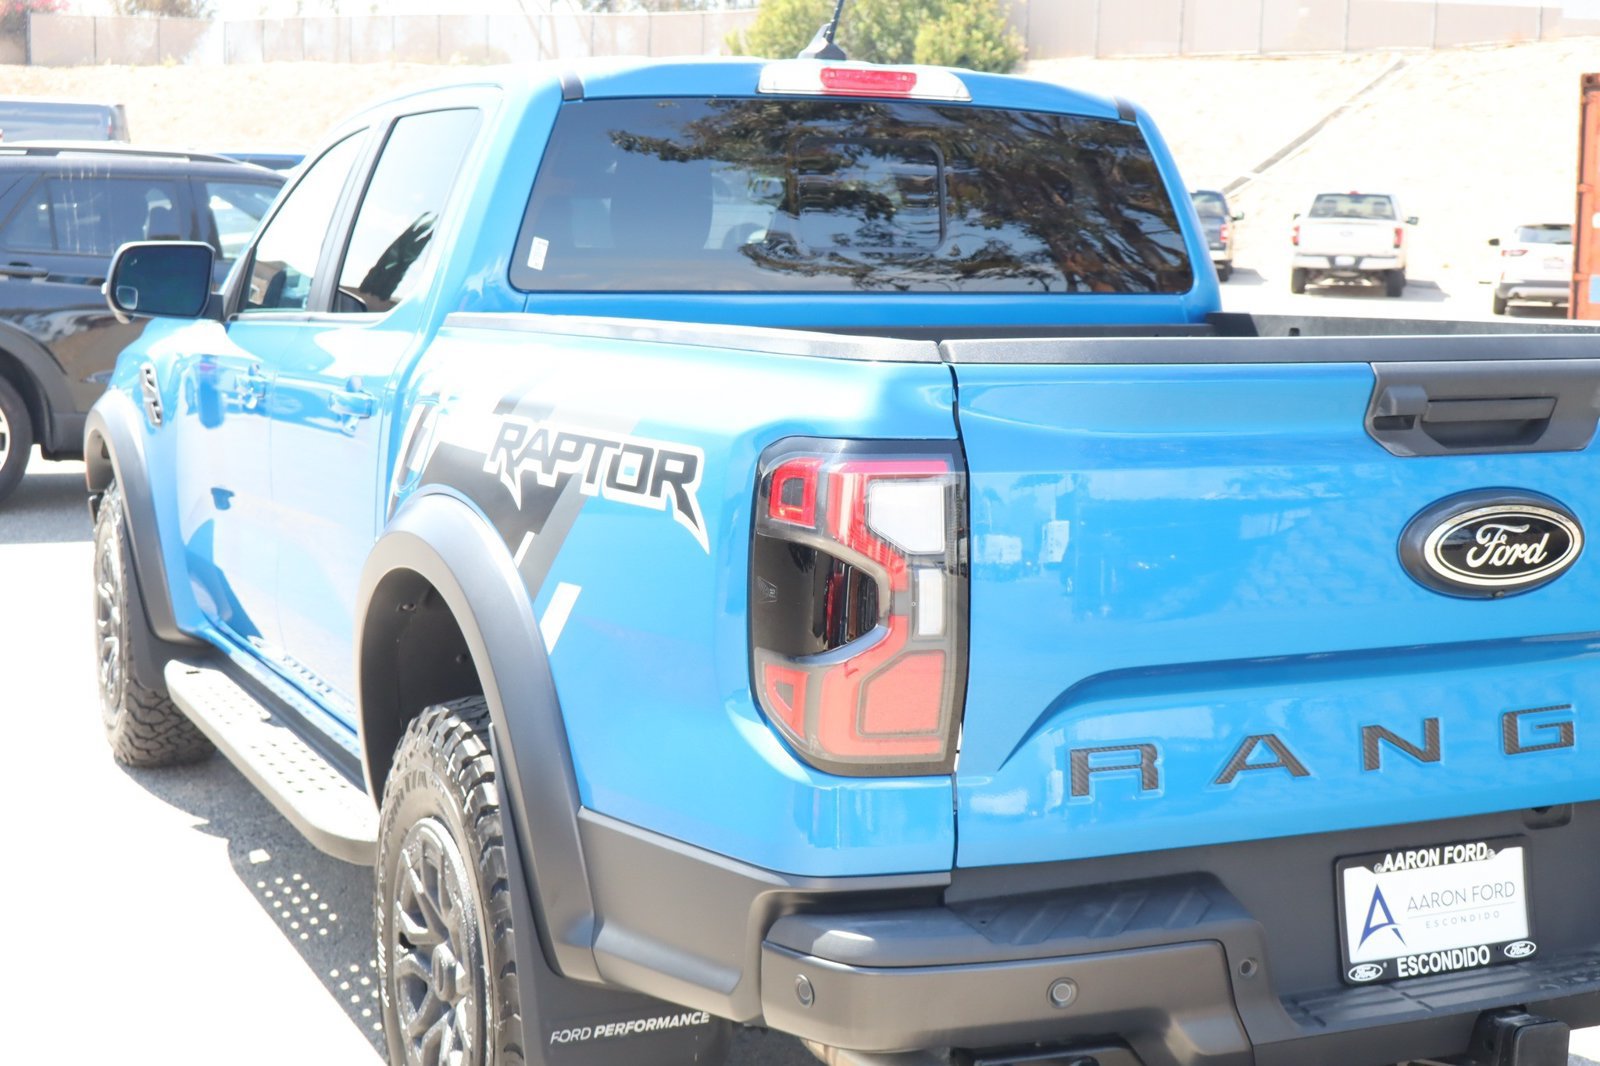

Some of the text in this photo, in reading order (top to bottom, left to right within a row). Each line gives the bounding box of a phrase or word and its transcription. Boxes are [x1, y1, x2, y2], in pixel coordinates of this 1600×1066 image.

[486, 417, 705, 542] RAPTOR
[1466, 524, 1549, 567] Ford
[1070, 704, 1575, 797] RANG
[1382, 842, 1488, 872] AARON FORD
[1407, 881, 1515, 912] AARON FORD
[1426, 910, 1500, 929] ESCONDIDO
[1397, 945, 1490, 977] ESCONDIDO
[550, 1011, 711, 1044] FORD PERFORMANCE
